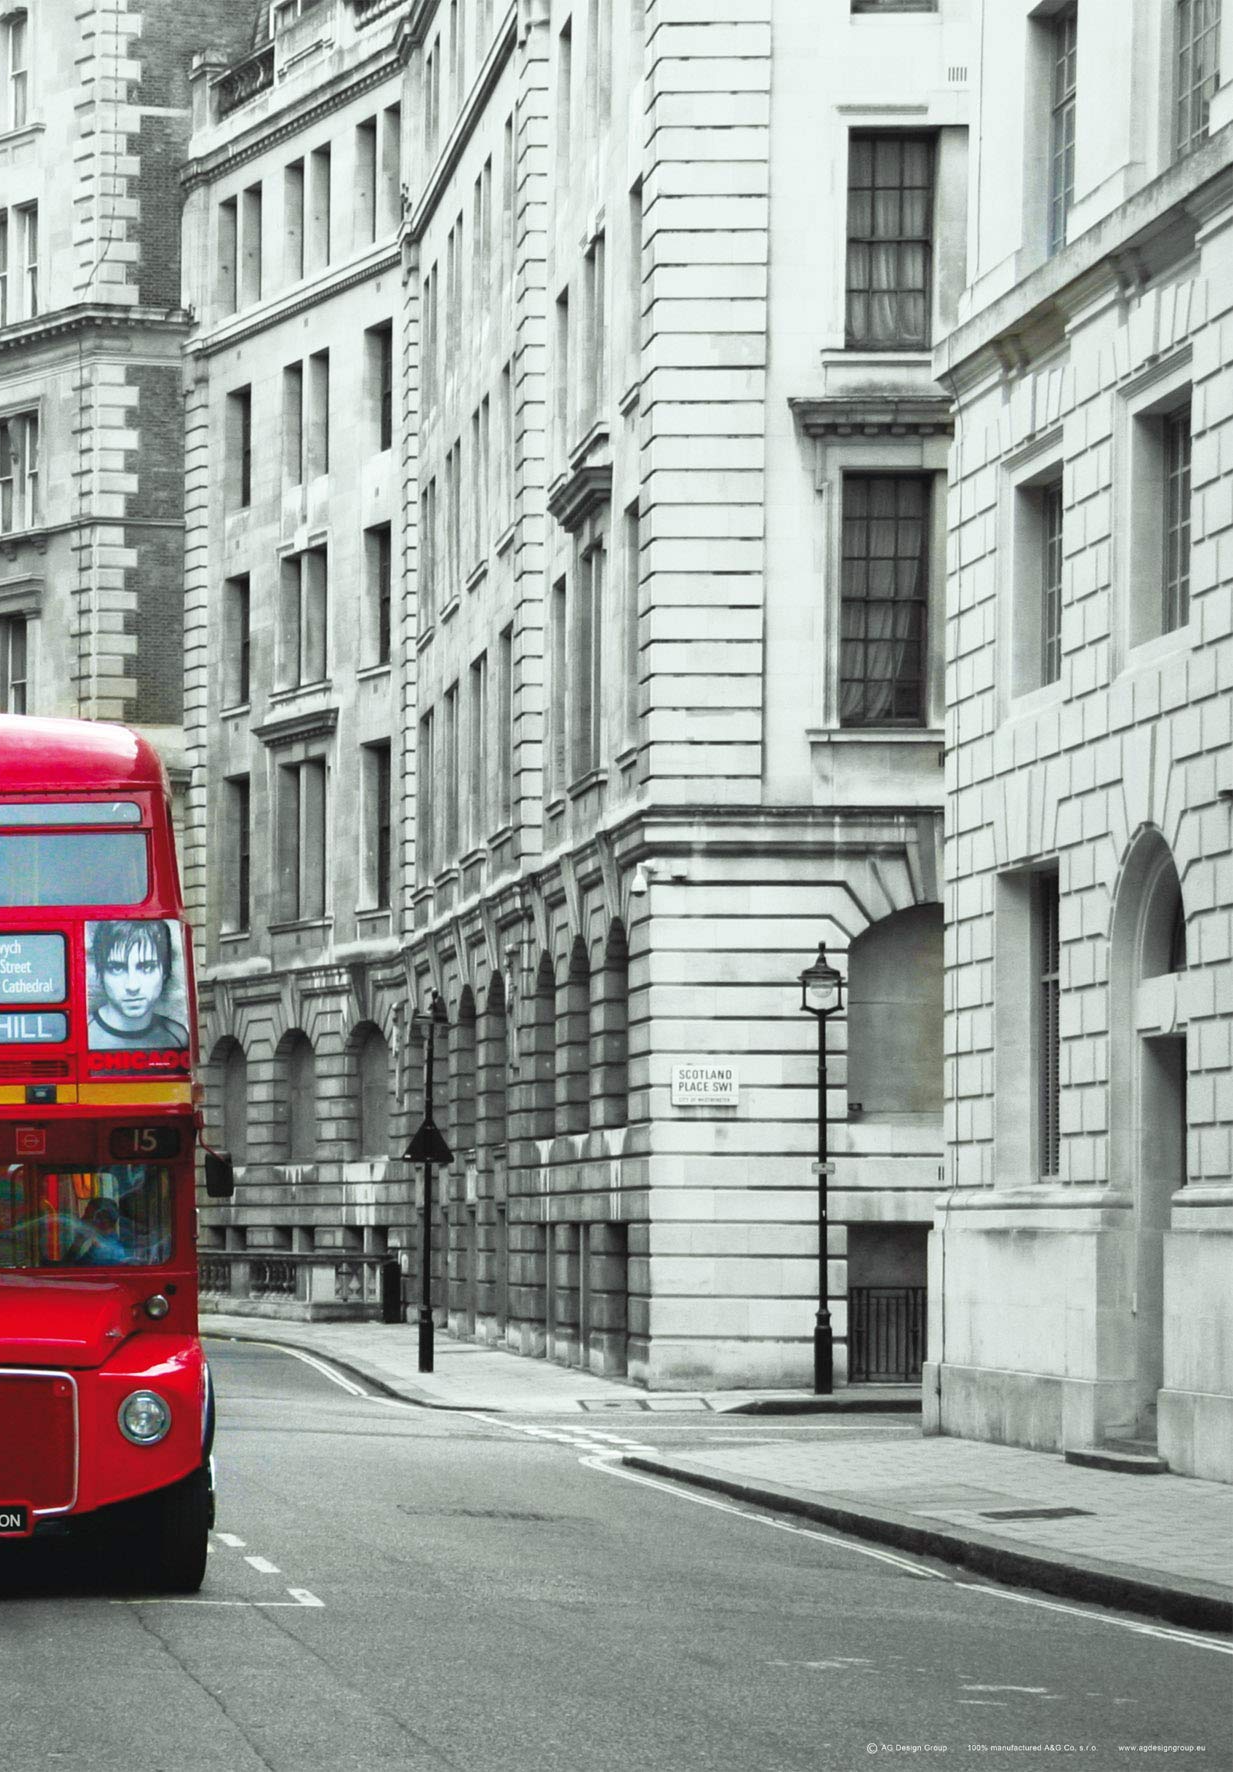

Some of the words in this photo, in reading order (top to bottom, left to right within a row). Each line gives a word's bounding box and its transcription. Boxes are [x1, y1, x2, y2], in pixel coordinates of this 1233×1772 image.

[0, 959, 32, 974] Street
[2, 978, 54, 993] Cathedral
[88, 1050, 191, 1071] CHICAGO
[679, 1069, 733, 1080] SCOTLAND
[679, 1082, 709, 1092] PLACE
[712, 1082, 733, 1092] SW1
[133, 1128, 158, 1151] 15
